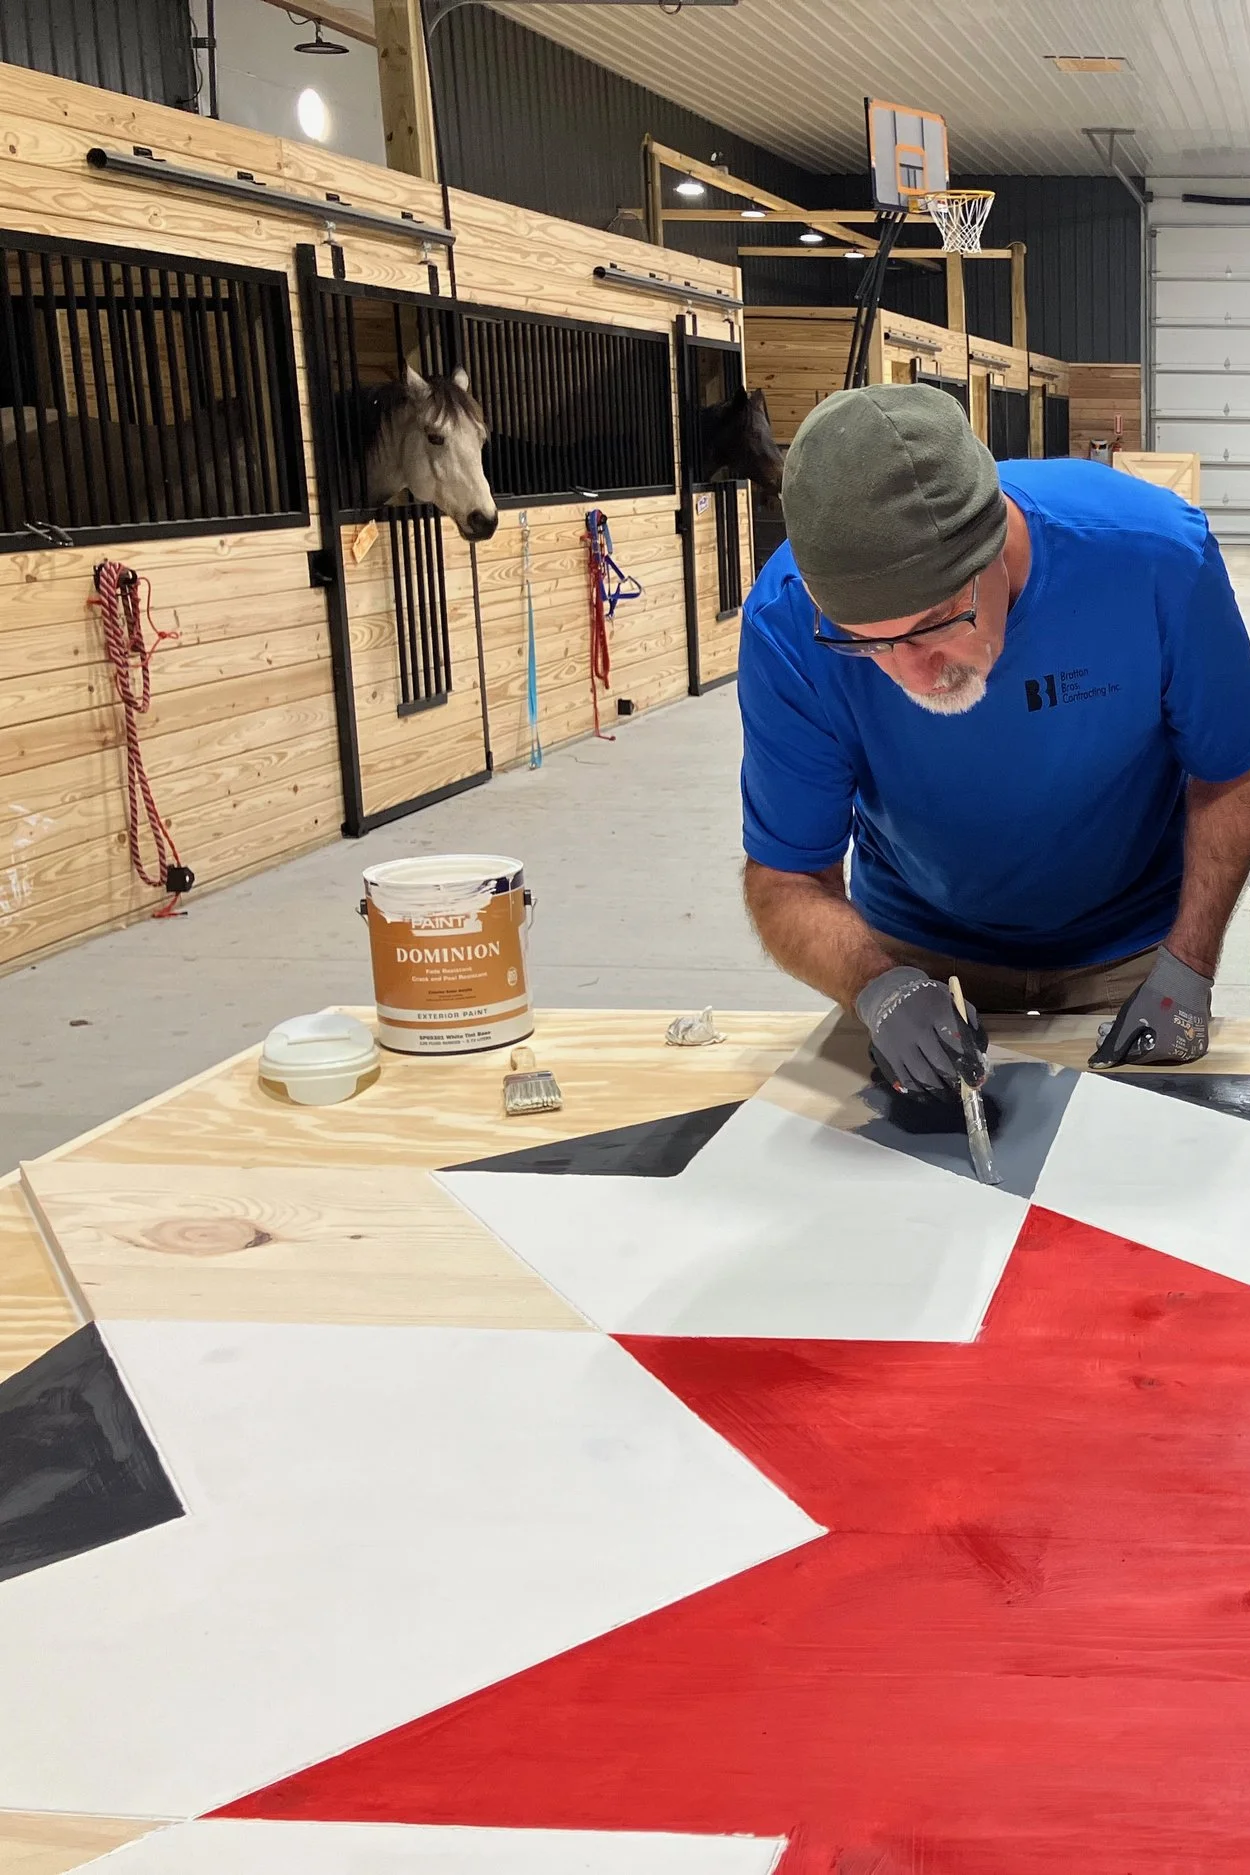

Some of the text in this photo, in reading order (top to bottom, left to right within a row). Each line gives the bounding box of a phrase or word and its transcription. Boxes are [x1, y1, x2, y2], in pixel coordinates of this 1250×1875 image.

[396, 940, 501, 964] DOMINION
[417, 1008, 488, 1020] EXTERIOR PAINT
